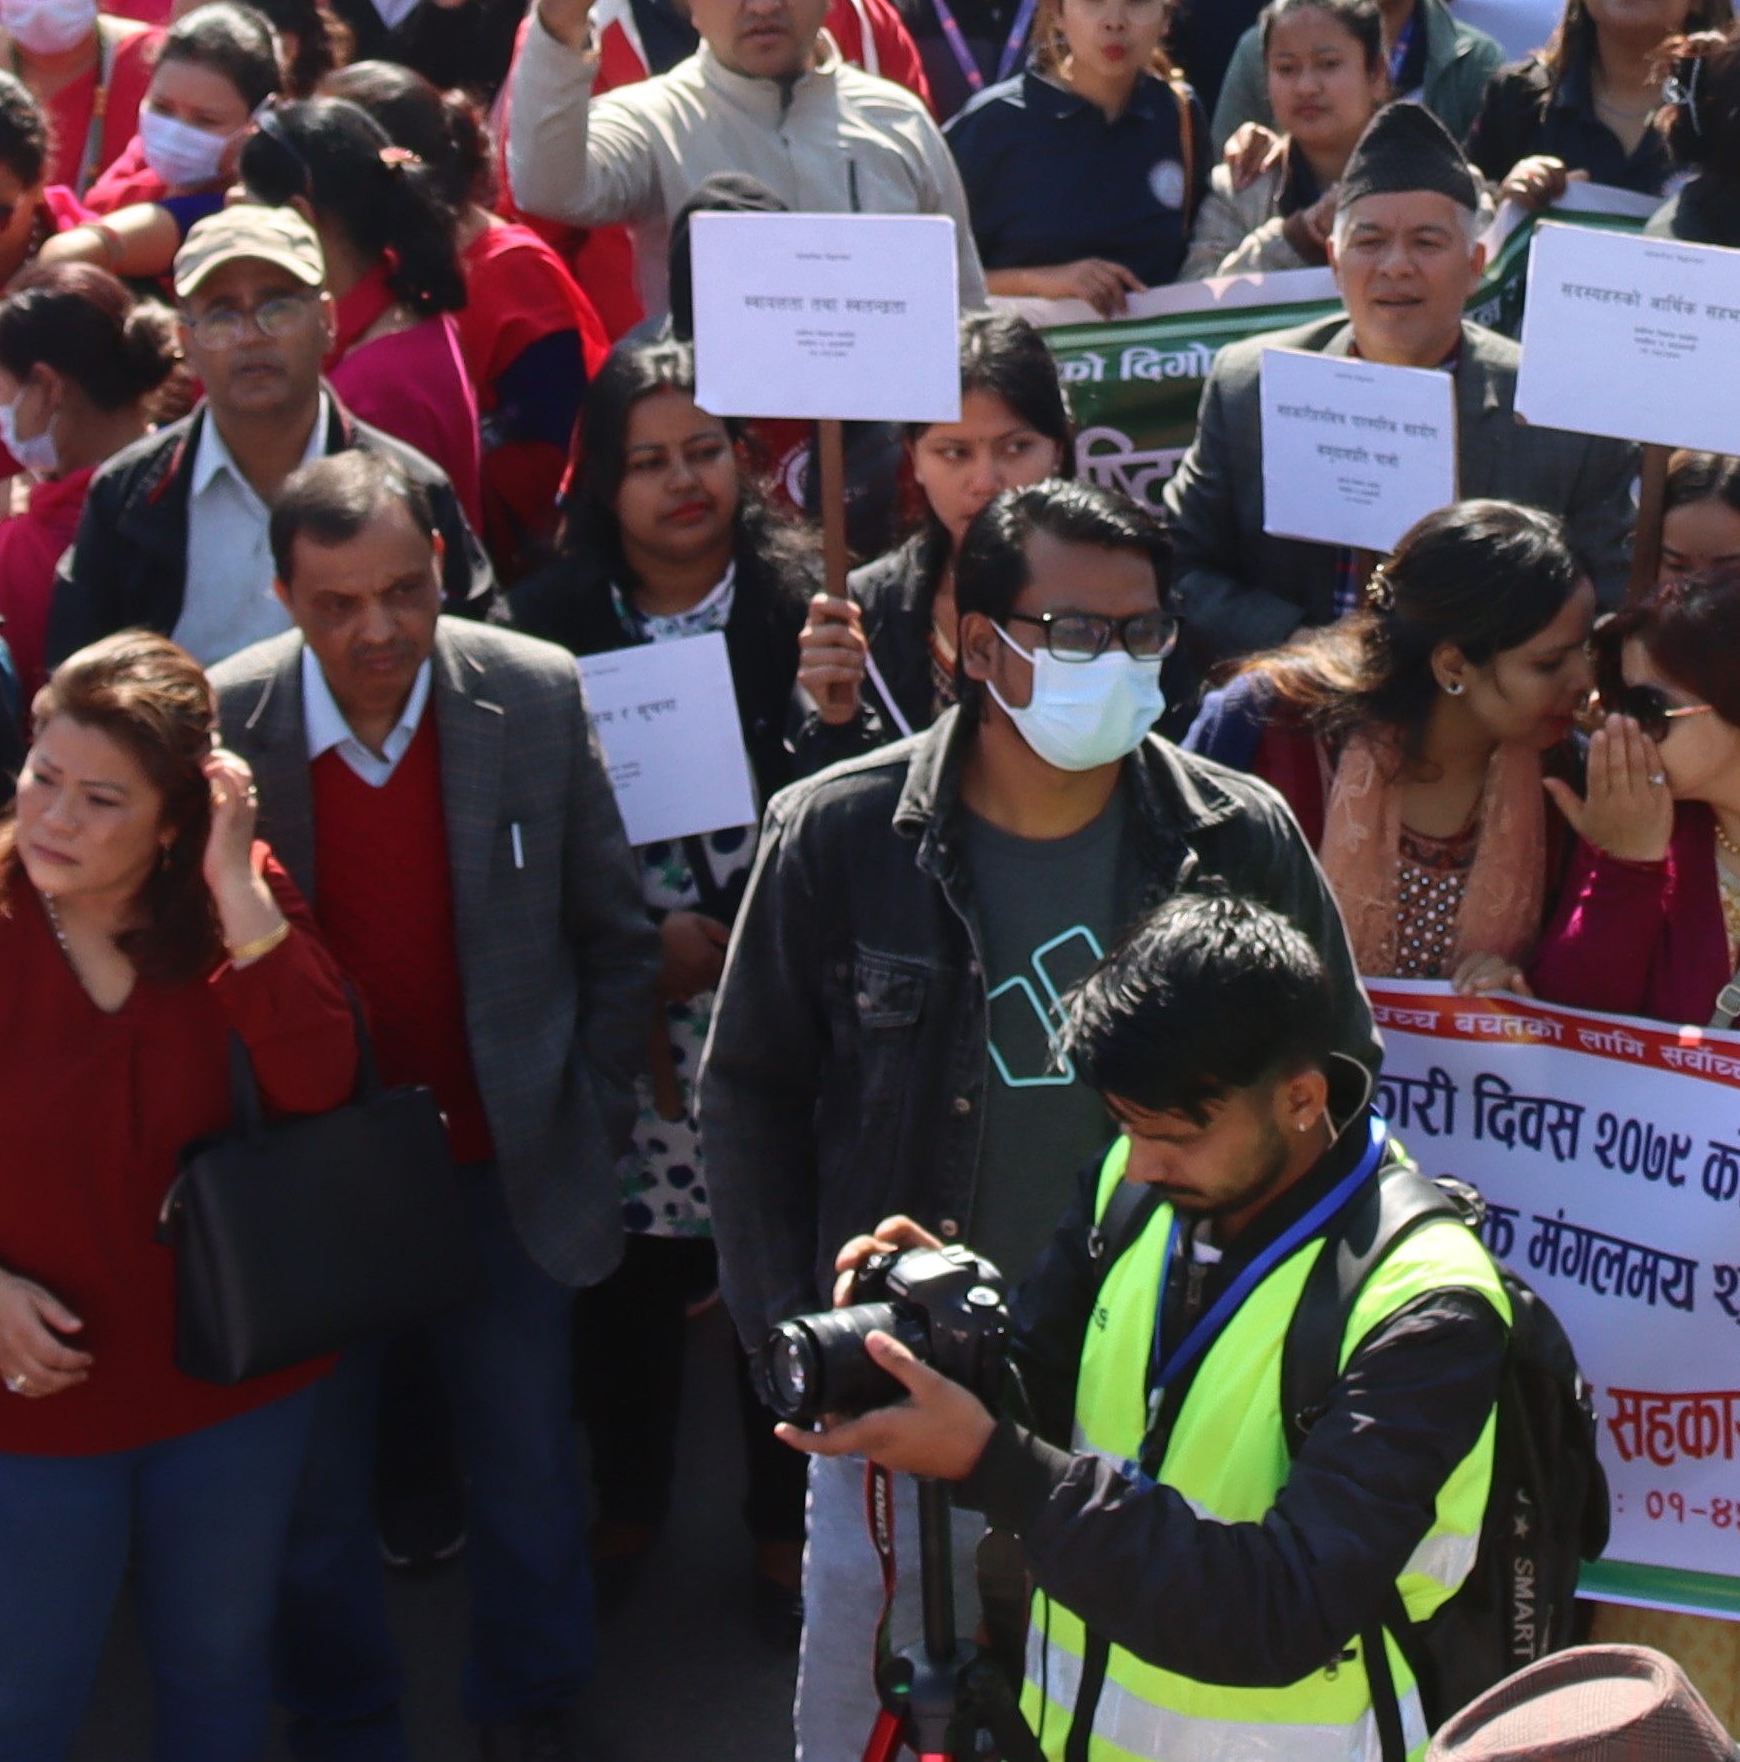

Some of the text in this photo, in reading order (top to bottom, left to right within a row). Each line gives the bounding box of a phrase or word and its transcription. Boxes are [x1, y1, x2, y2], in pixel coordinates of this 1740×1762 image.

[1453, 1009, 1564, 1043] बचतको
[1577, 1026, 1646, 1058] लागि
[1472, 1071, 1586, 1162] दिवस
[1593, 1111, 1693, 1187] २०७९
[1527, 1206, 1700, 1313] मंगलमय
[1513, 1557, 1536, 1660] SMART
